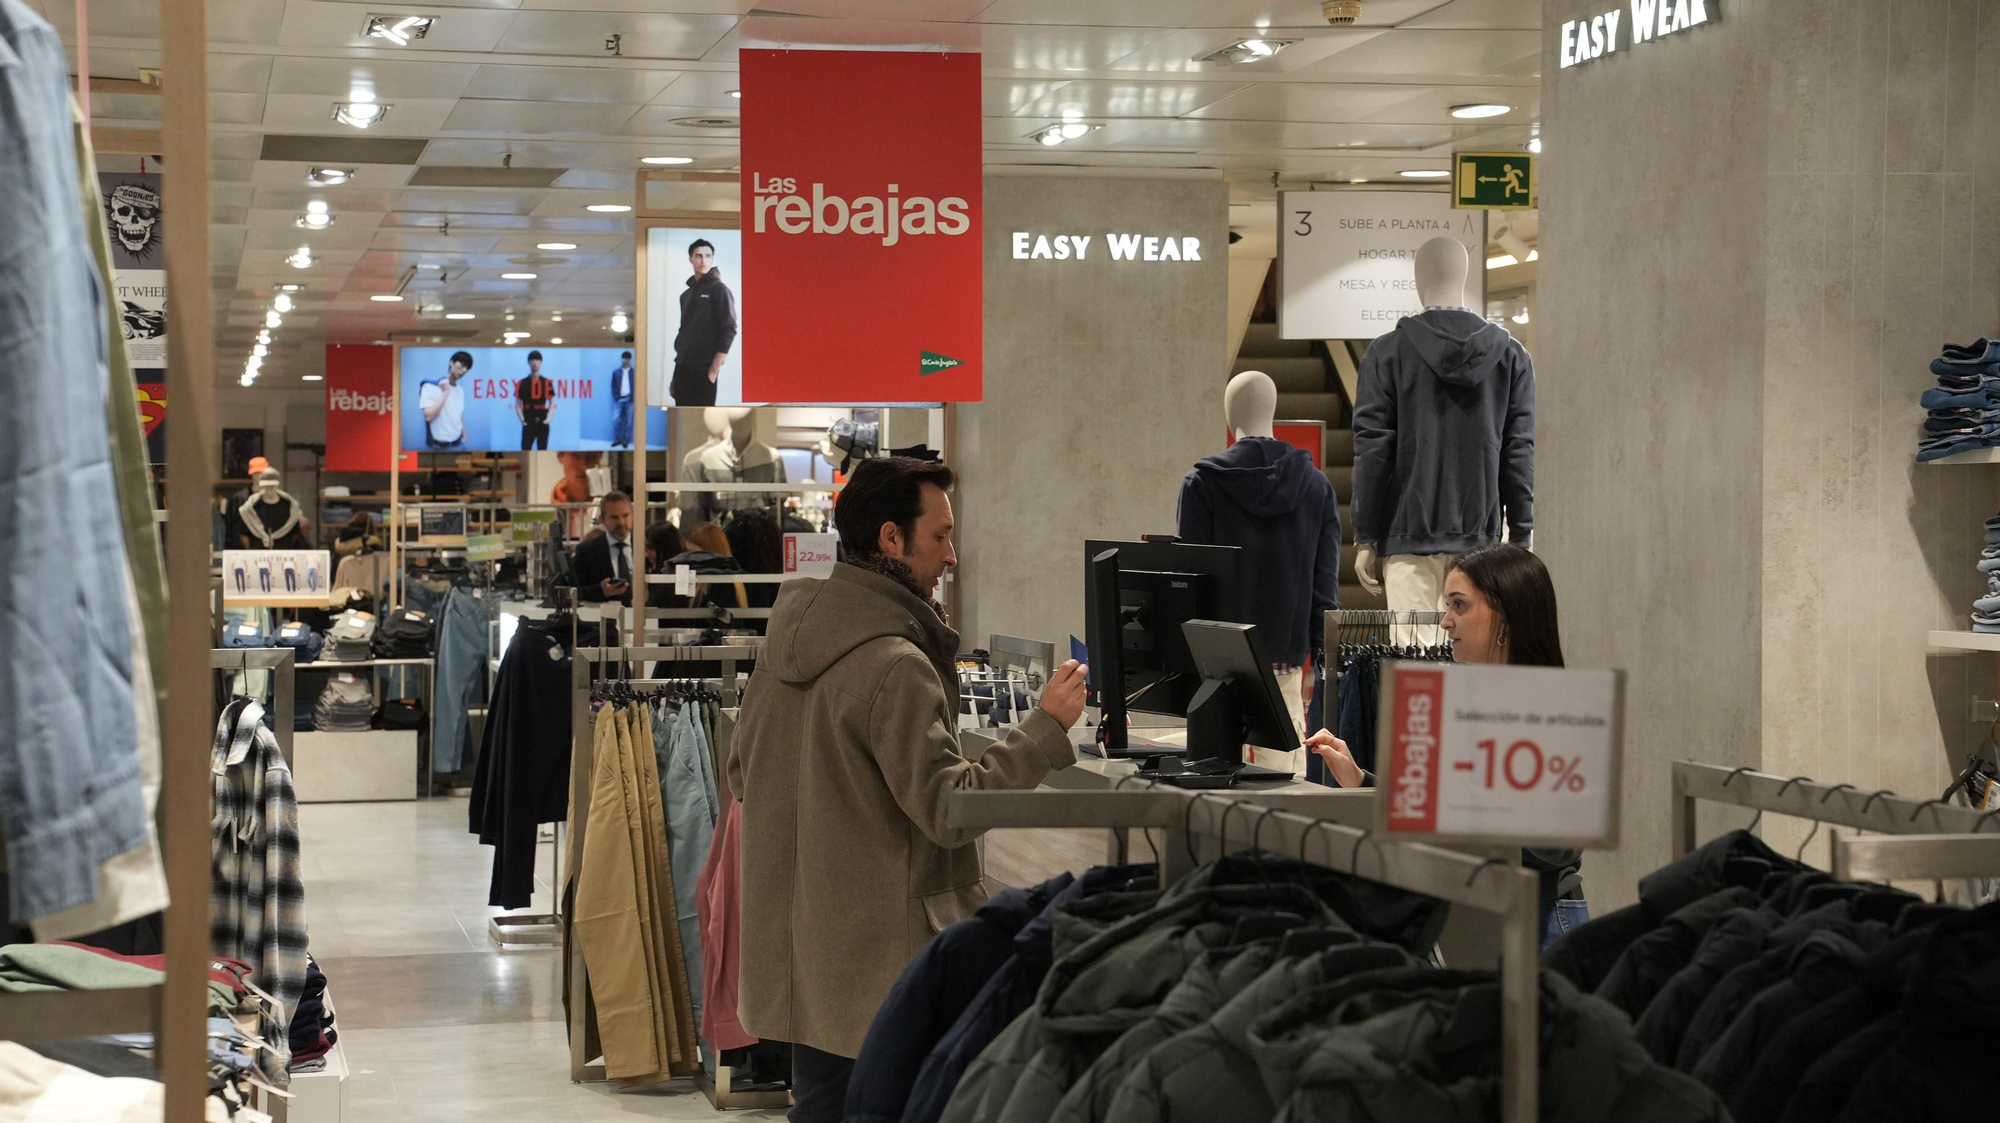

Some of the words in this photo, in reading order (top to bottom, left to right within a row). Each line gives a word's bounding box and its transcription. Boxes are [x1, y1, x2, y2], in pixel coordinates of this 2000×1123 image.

[1560, 9, 1621, 69] EASY
[753, 172, 797, 194] Las
[753, 183, 970, 246] rebajas
[1294, 211, 1312, 236] 3
[1339, 219, 1373, 229] SUBE
[1378, 219, 1387, 229] A
[1392, 219, 1439, 230] PLANTA
[1443, 220, 1450, 230] 4
[1012, 232, 1091, 260] EASY
[1106, 233, 1202, 261] WEAR
[1358, 249, 1405, 260] HOGAR
[132, 286, 168, 298] WHEE
[1339, 280, 1375, 290] MESA
[1380, 280, 1388, 290] Y
[1393, 280, 1417, 290] REG
[474, 379, 522, 399] EASY
[531, 379, 593, 400] DENIM
[330, 390, 393, 416] rebaja
[1397, 694, 1437, 820] rebajas
[1453, 738, 1586, 794] -10%
